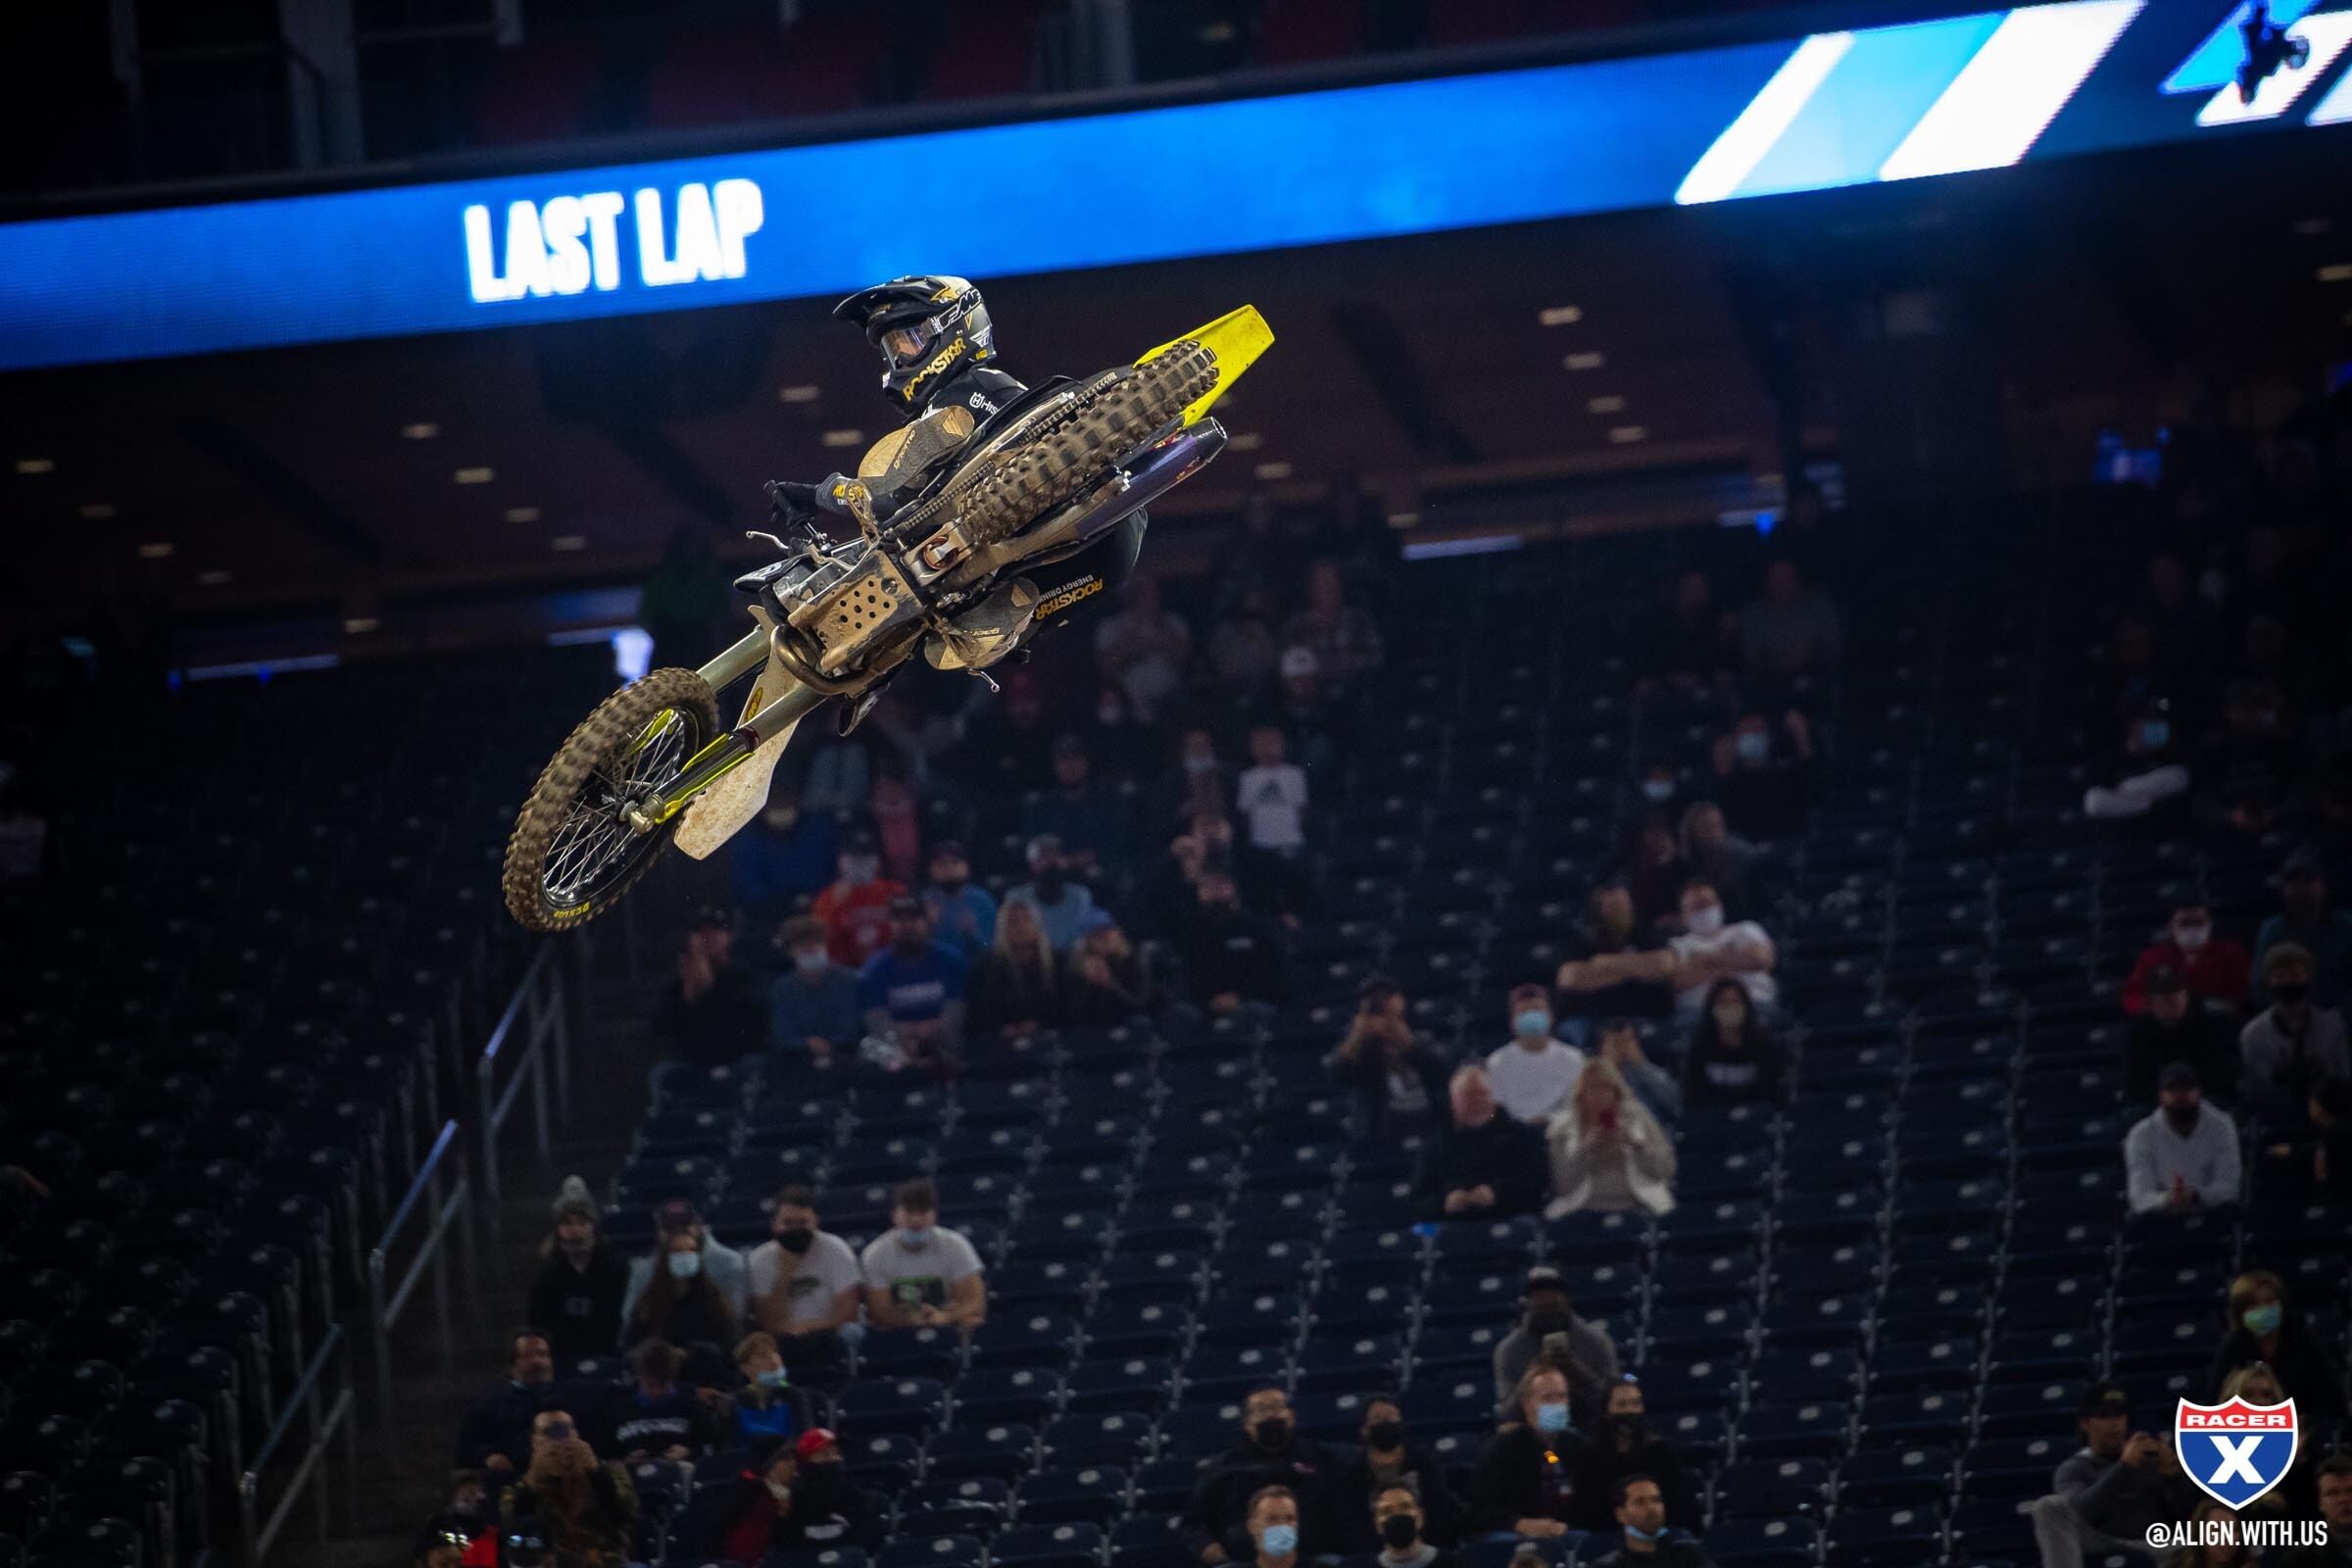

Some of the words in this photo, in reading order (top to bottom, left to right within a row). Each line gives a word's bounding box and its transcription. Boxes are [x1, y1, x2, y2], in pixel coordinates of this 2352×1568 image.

[464, 191, 624, 303] LAST
[634, 178, 763, 287] LAP
[1035, 578, 1103, 620] ROCKSTAR
[1061, 574, 1094, 592] ENERGY
